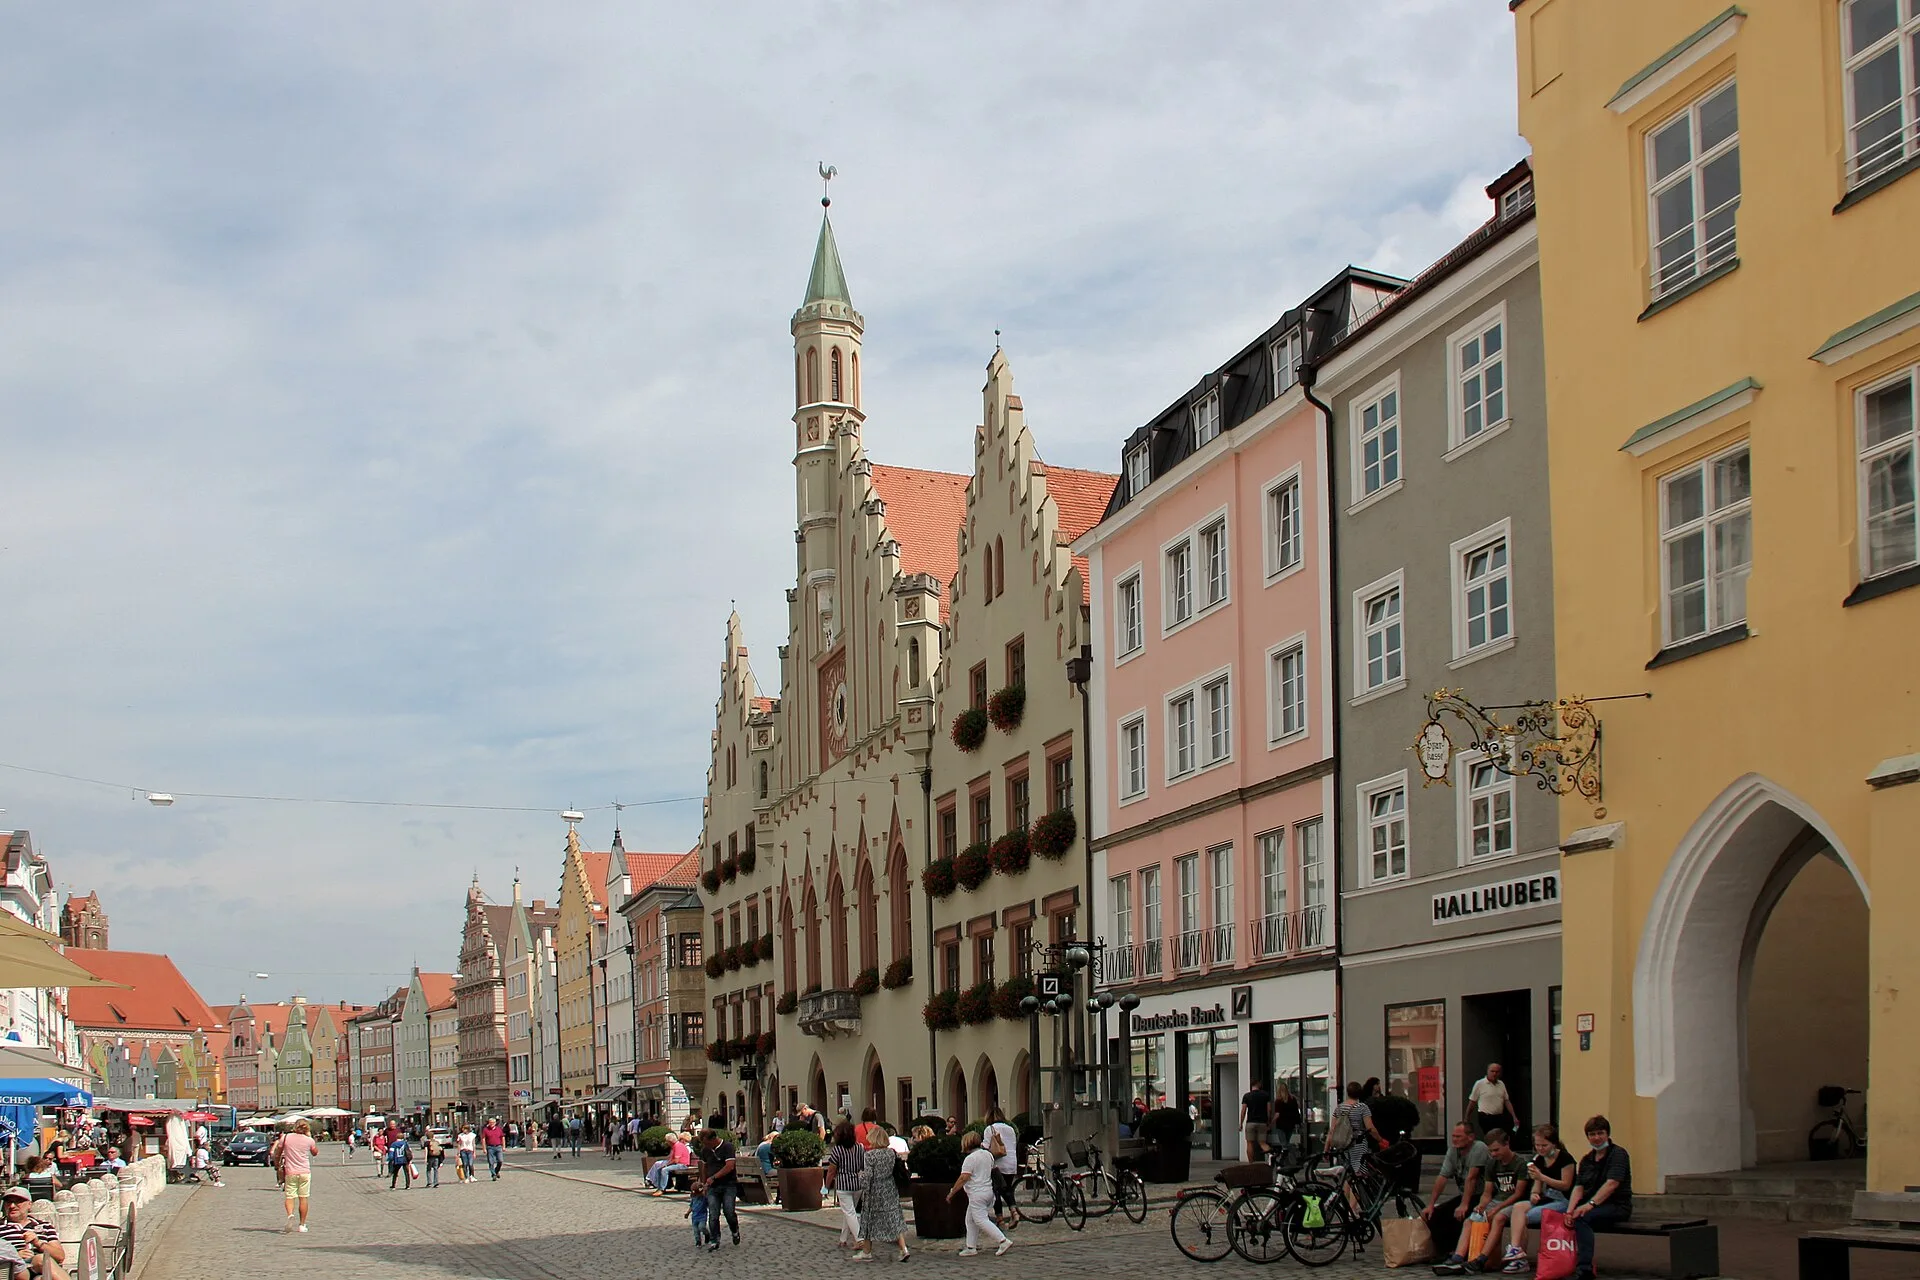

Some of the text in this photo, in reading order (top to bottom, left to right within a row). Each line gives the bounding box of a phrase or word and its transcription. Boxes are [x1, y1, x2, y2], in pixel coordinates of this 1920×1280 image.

[1433, 876, 1557, 920] HALLHUBER
[1131, 1003, 1225, 1032] Deutsche Bank
